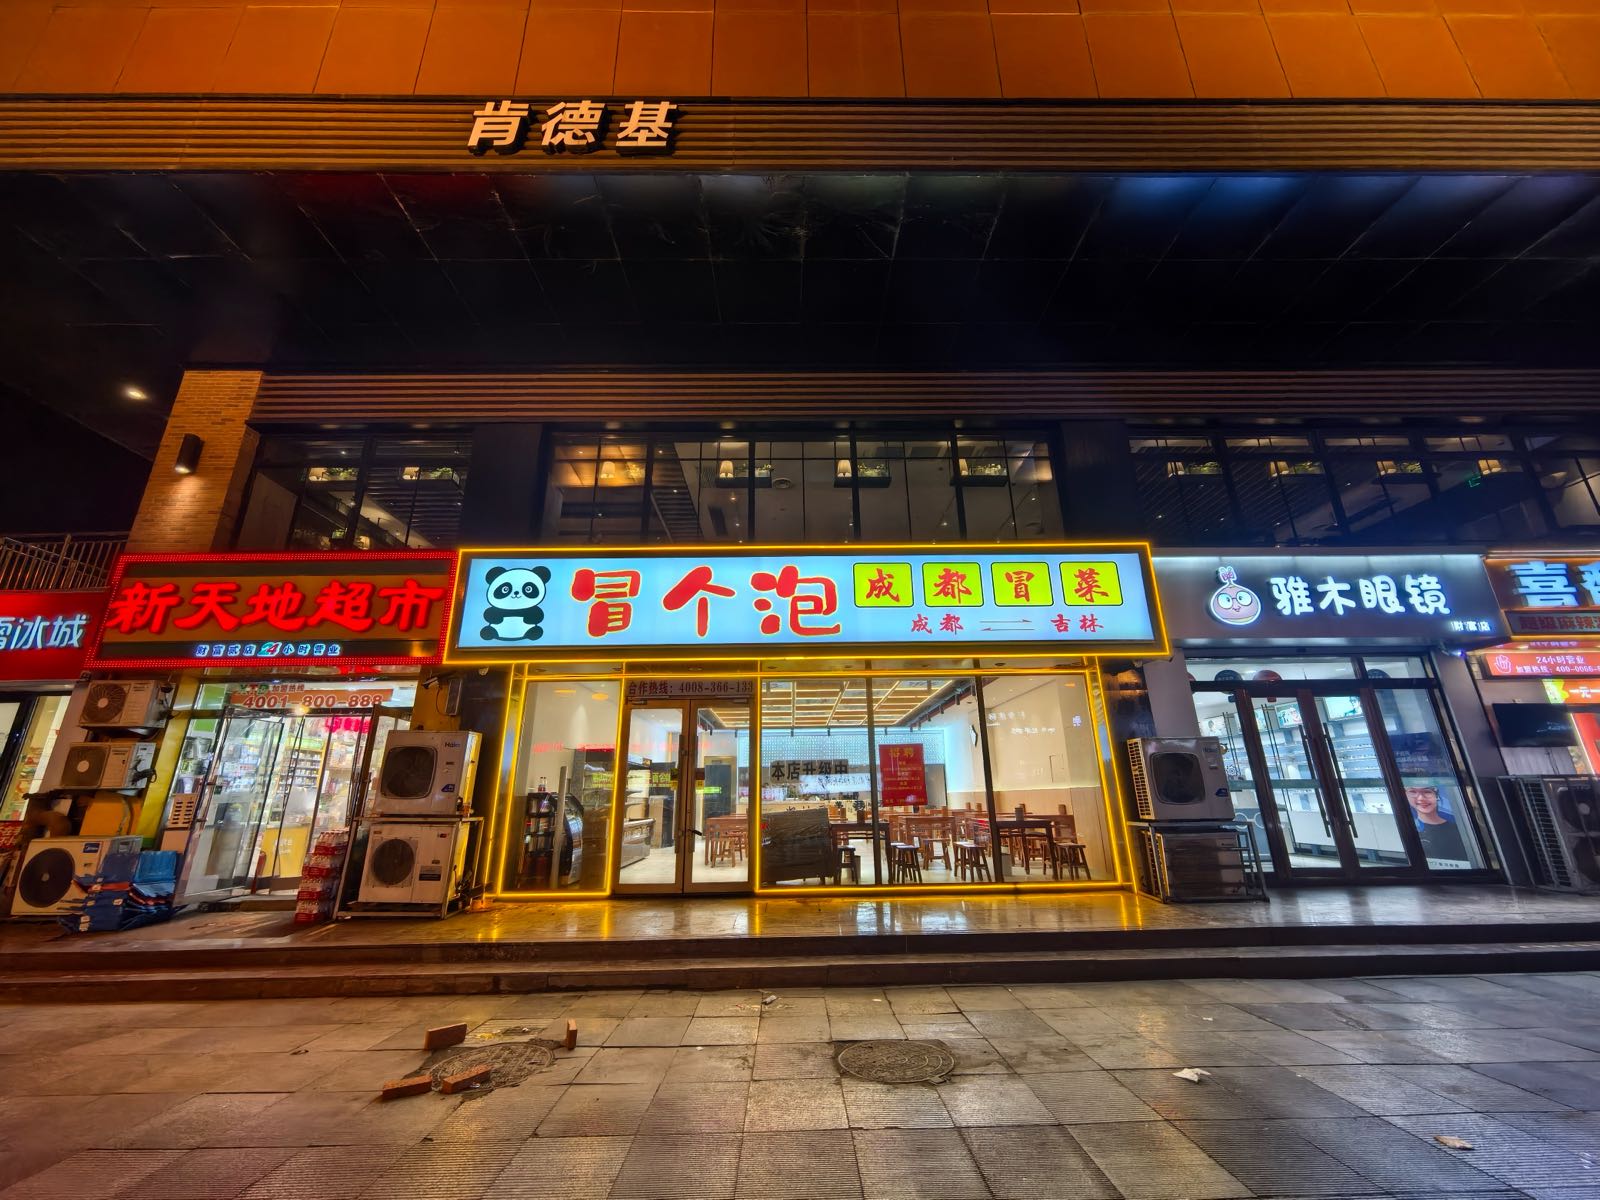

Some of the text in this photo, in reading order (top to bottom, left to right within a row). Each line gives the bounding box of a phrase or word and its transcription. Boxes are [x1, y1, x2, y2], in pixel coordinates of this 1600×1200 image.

[467, 100, 678, 147] 肯德基
[108, 579, 445, 633] 新天地超市
[570, 565, 840, 638] 冒个泡
[865, 567, 1110, 604] 成都冒菜
[1269, 573, 1451, 616] 雅木眼镜
[910, 613, 1104, 635] 成都 吉林
[242, 693, 384, 708] 4001-800-888
